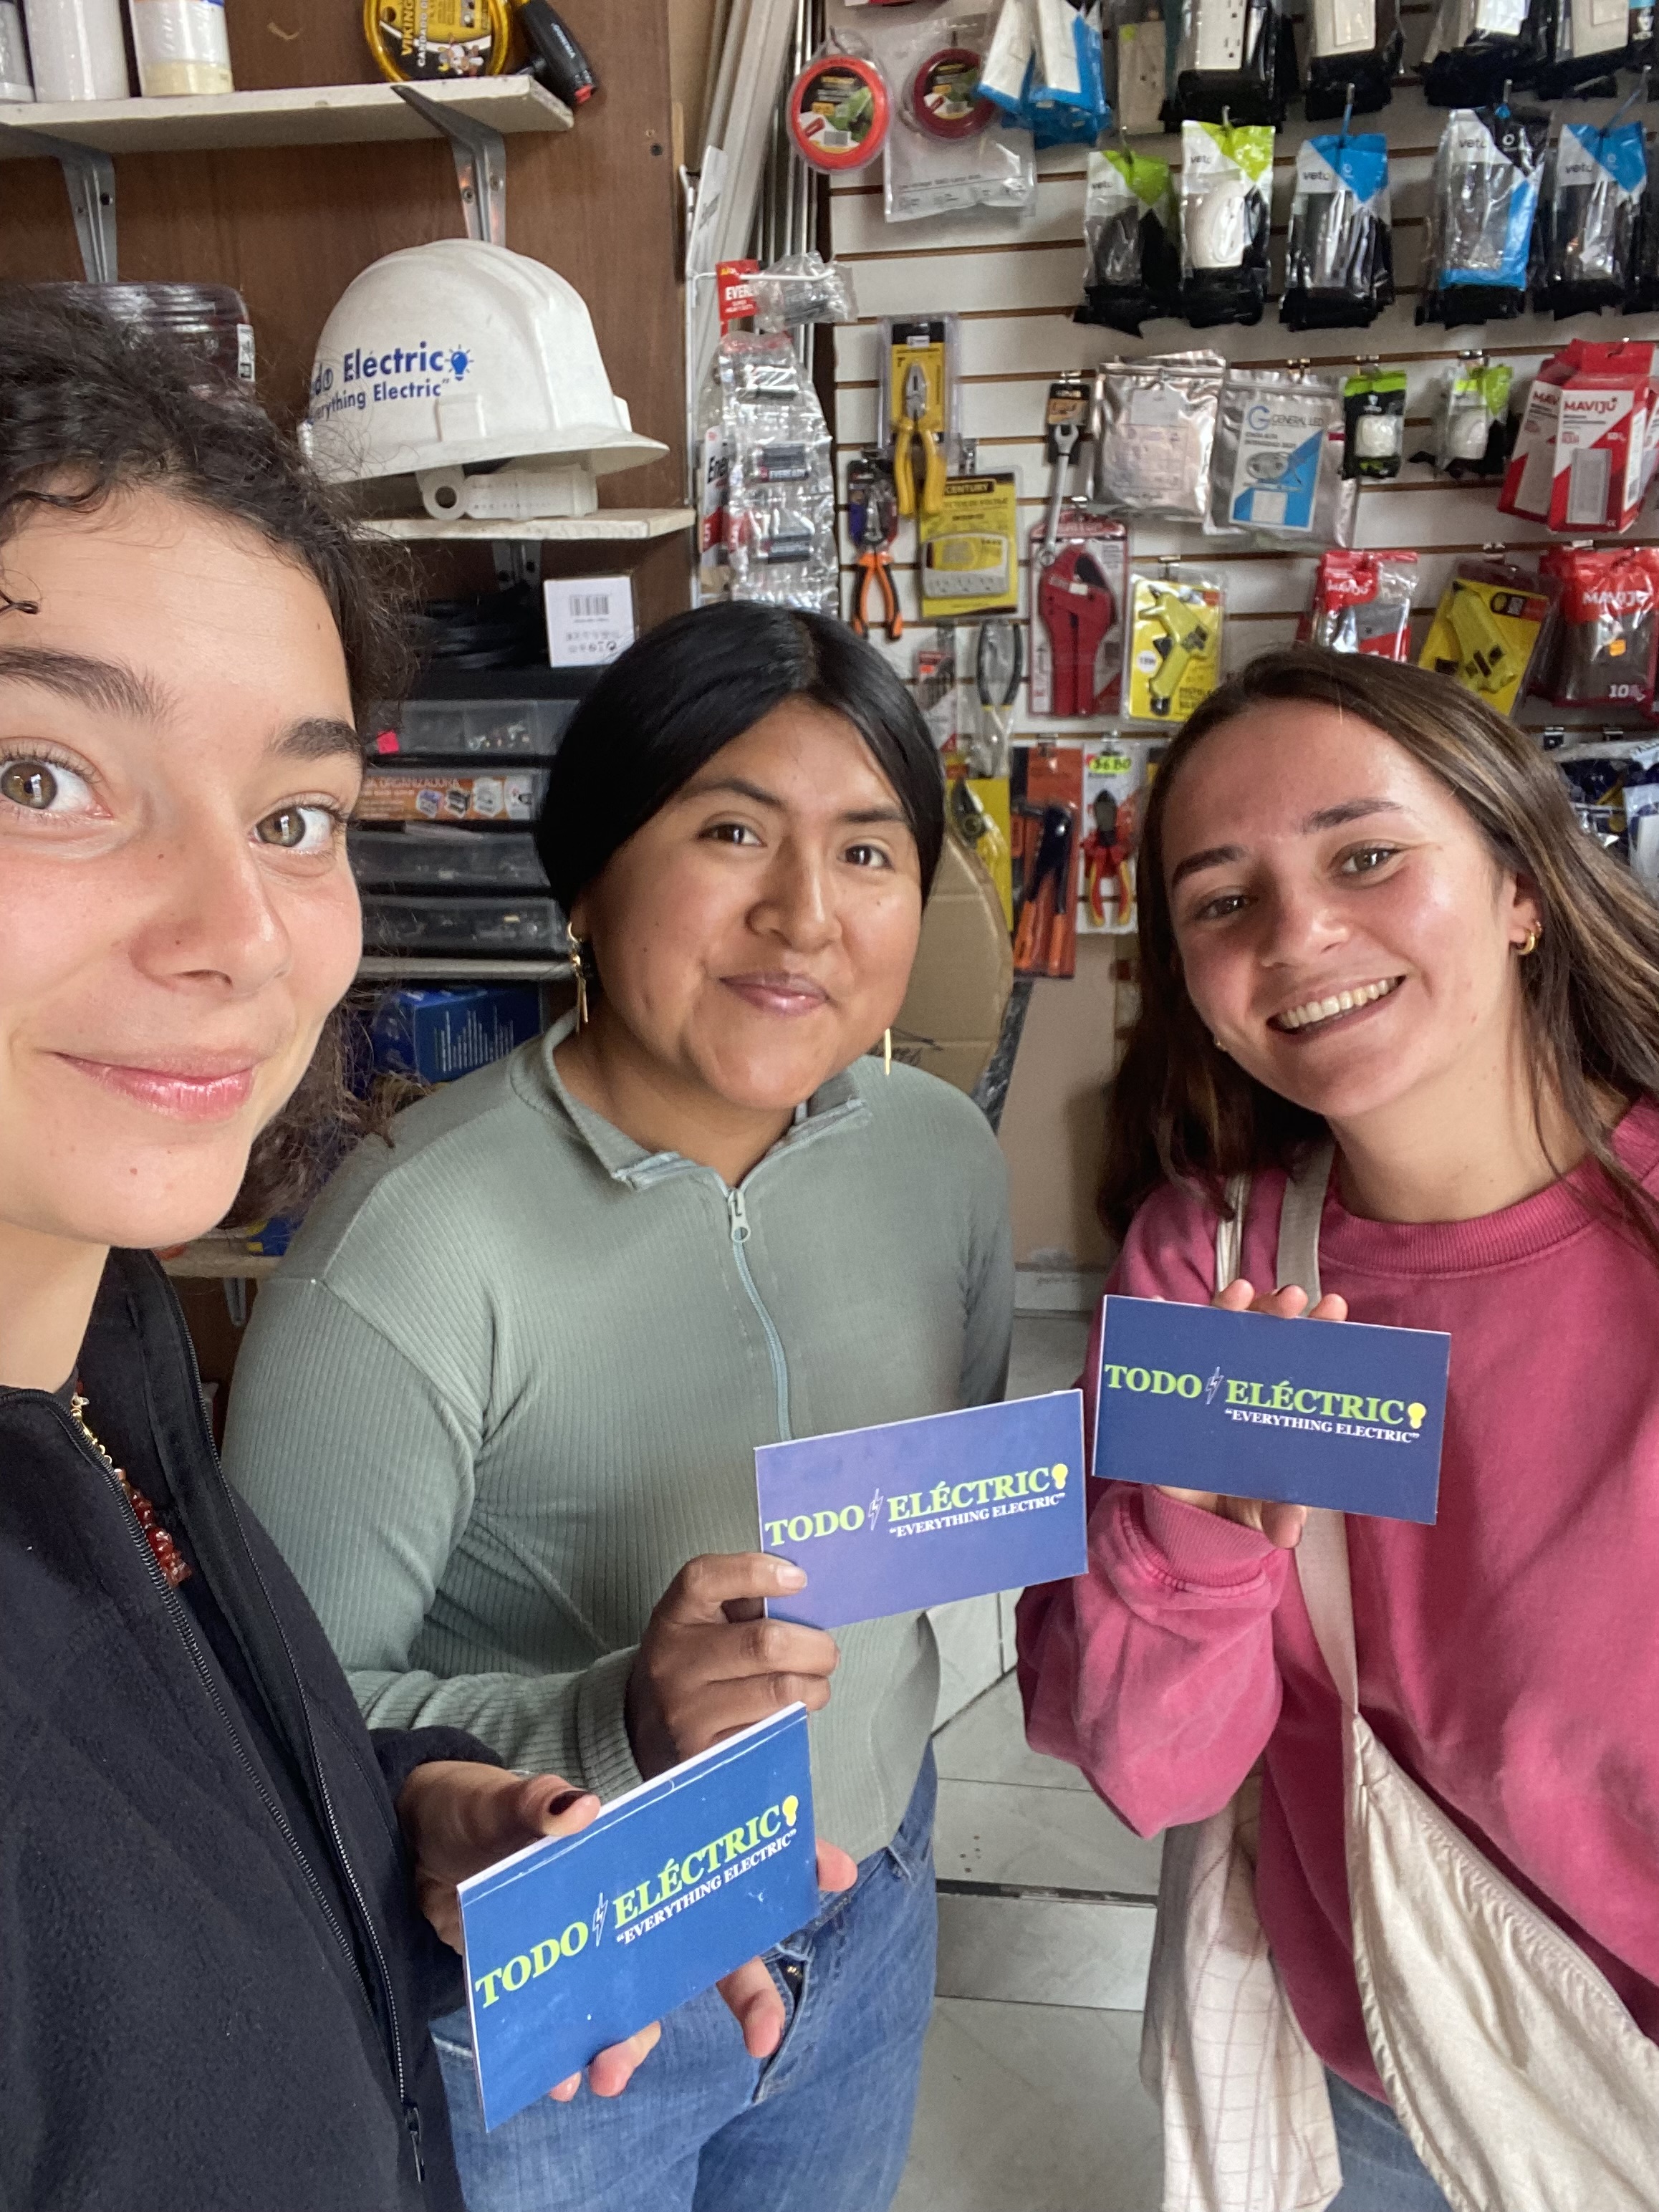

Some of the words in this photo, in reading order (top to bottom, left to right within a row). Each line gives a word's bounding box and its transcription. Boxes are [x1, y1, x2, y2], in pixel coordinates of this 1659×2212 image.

[344, 341, 444, 383] Eléctric
[1105, 1363, 1203, 1399] TODO
[1225, 1379, 1405, 1425] ELÉCTRIC
[764, 1504, 865, 1547] TODO
[887, 1467, 1051, 1522] ELÉCTRIC
[474, 1921, 589, 2009] TODO
[612, 1804, 782, 1930] ELÉCTRIC
